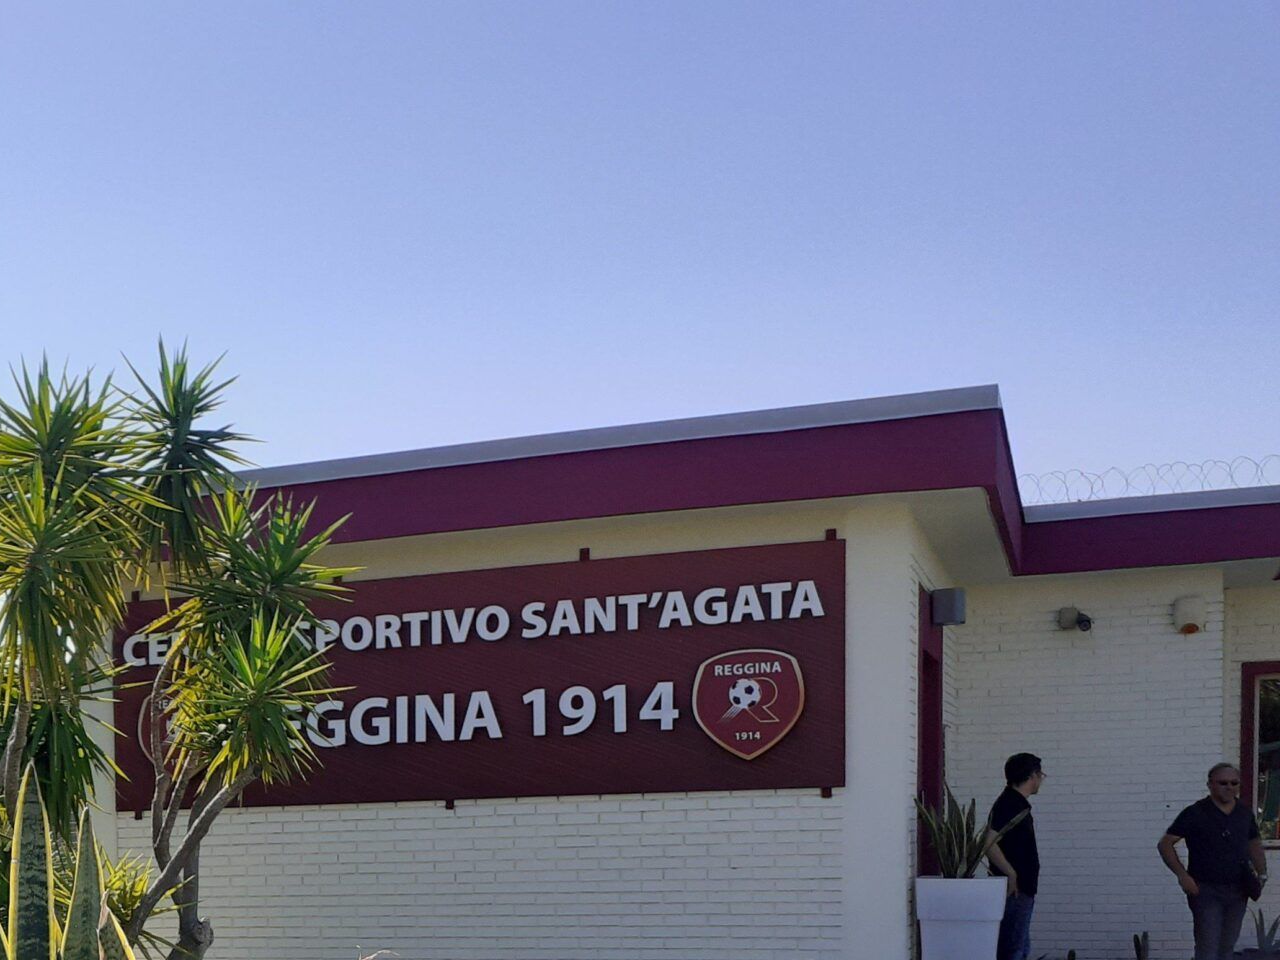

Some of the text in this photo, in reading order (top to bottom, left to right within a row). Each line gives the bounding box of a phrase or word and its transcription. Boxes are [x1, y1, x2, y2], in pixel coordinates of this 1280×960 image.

[521, 580, 825, 639] SANT'AGATA
[714, 661, 782, 676] REGGINA
[522, 681, 680, 737] 1914
[735, 731, 761, 741] 1914
